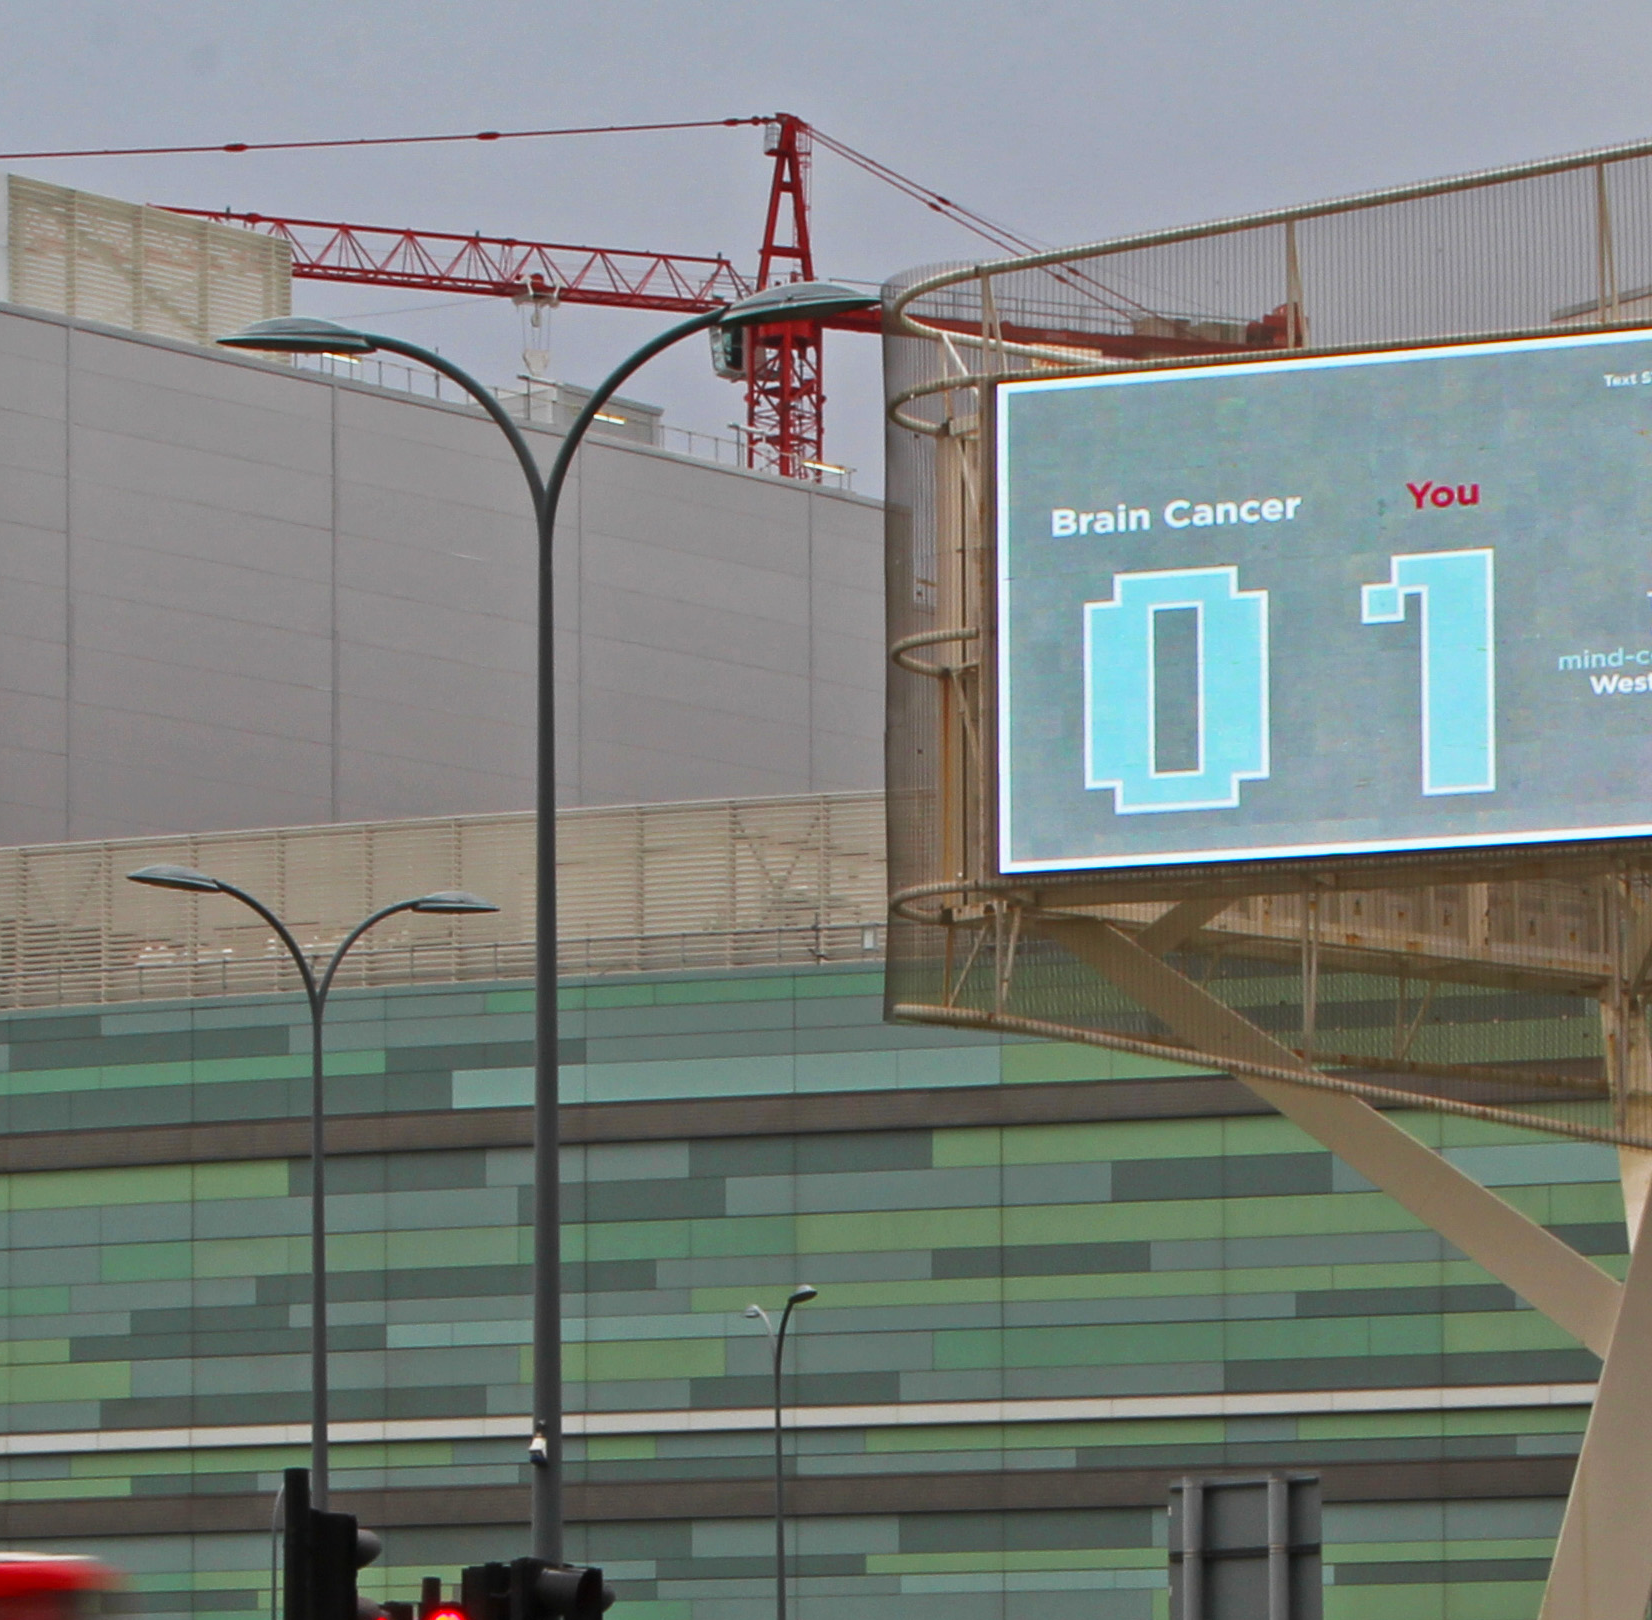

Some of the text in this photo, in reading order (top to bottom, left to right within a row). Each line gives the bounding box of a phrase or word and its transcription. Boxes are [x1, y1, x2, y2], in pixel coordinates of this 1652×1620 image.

[1604, 373, 1638, 388] Text
[1406, 481, 1480, 509] You
[1051, 496, 1302, 538] Brain Cancer
[1084, 547, 1496, 815] 0 1
